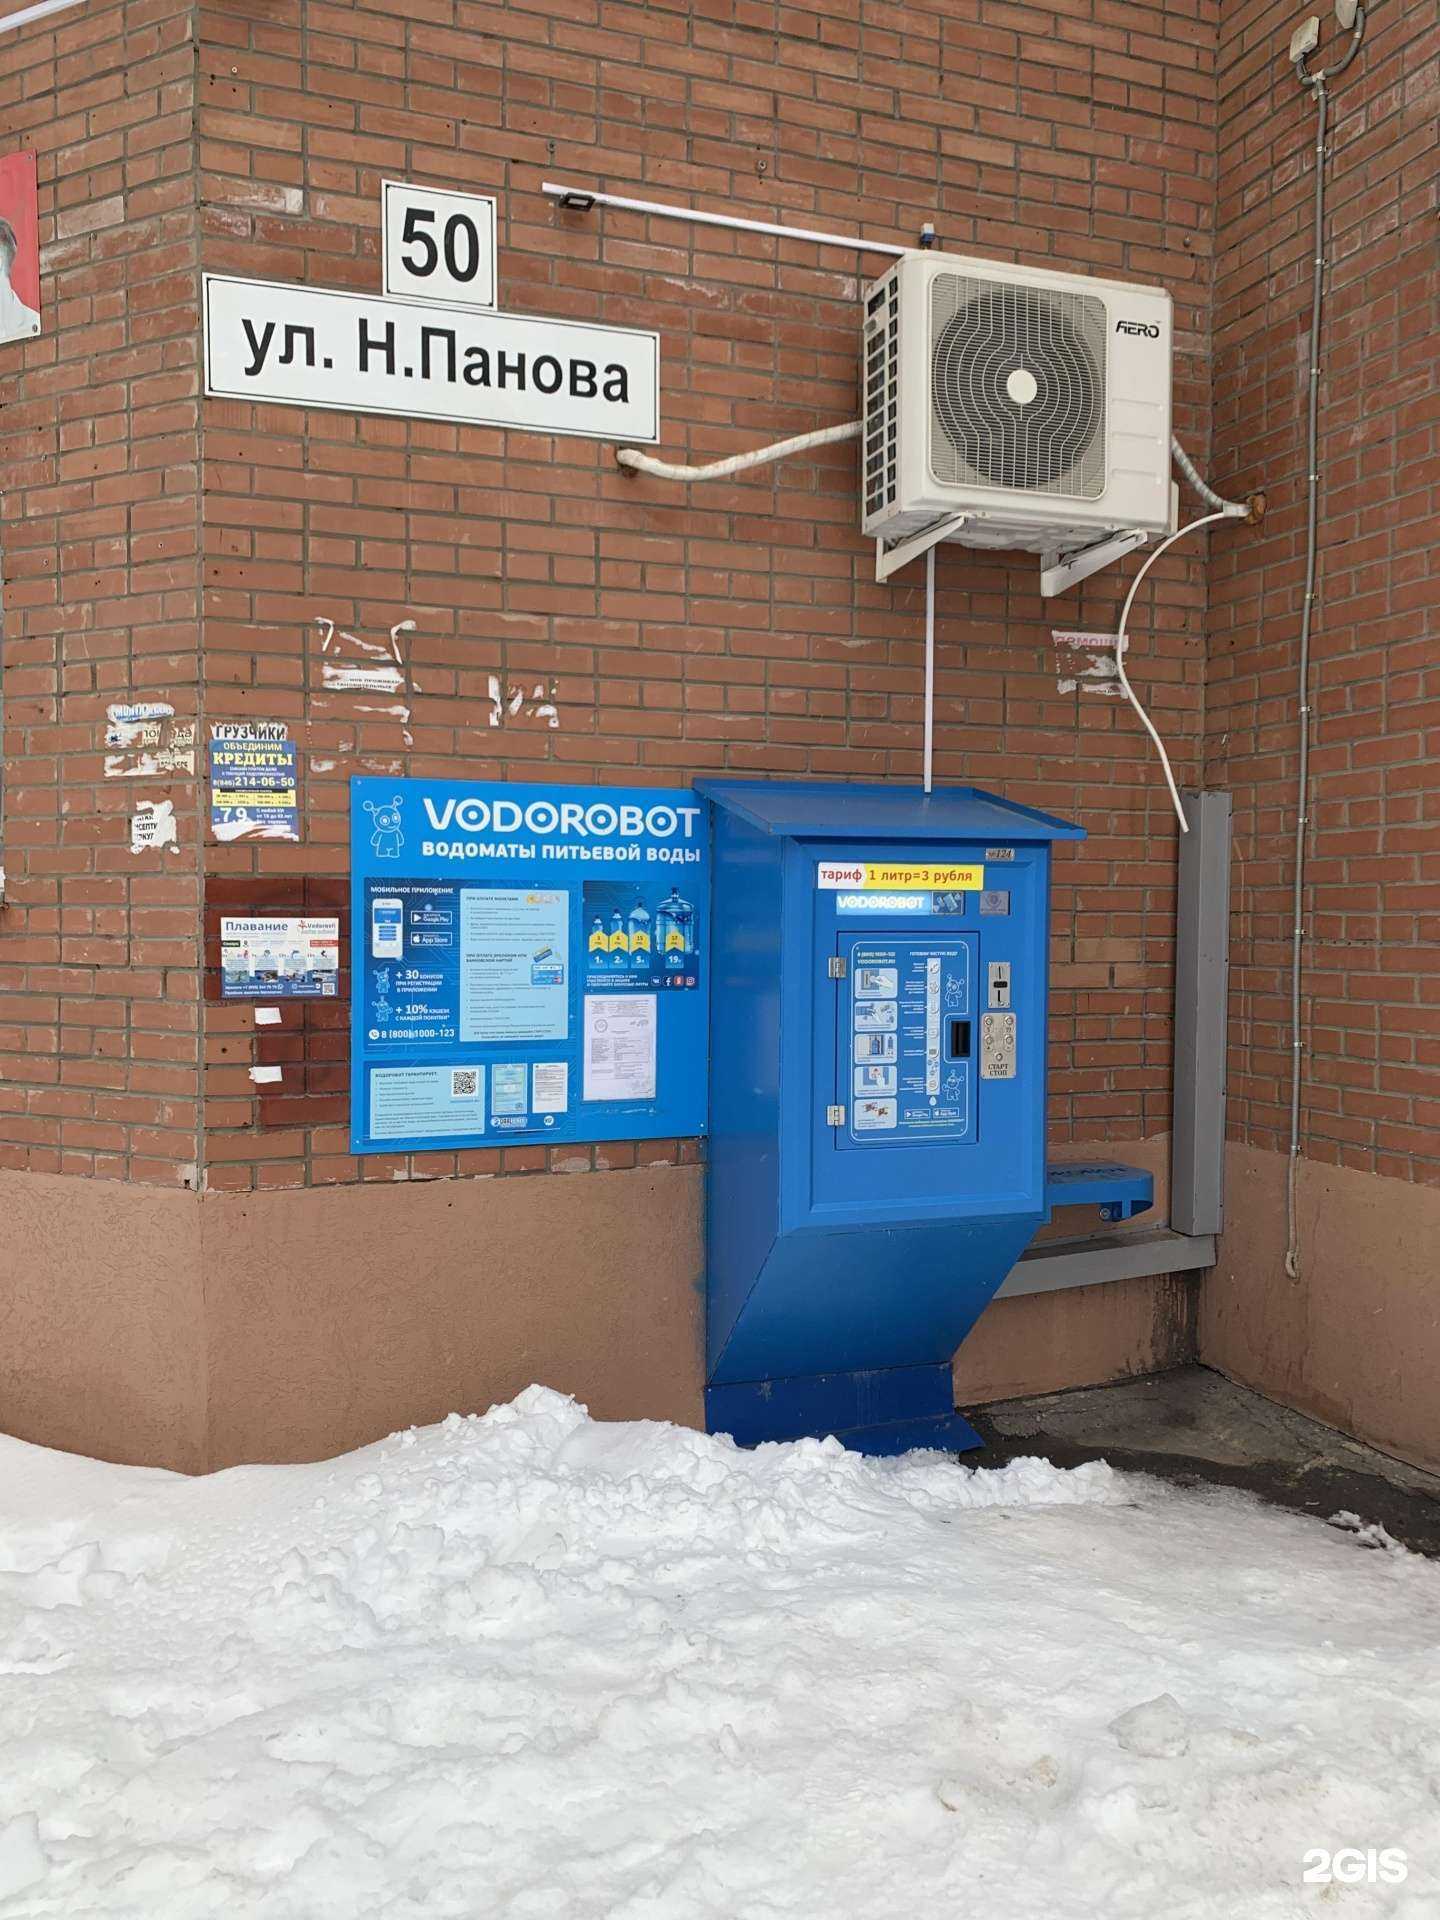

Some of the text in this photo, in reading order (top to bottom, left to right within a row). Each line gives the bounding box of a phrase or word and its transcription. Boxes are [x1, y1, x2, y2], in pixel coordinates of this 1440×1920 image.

[401, 208, 479, 282] 50
[242, 317, 629, 403] ул. Н.Панова
[216, 724, 286, 740] ГРУЗЧИКИ
[223, 742, 282, 751] ОБЪЕДИНИМ
[212, 752, 293, 766] КРЕДИТЫ
[423, 797, 701, 838] VODOROBOT
[422, 841, 701, 865] ВОДОМАТЫ ПИТЬЕВОЙ ВОДЫ
[820, 868, 973, 883] тариф 1 литр=3 рубля
[837, 895, 925, 909] VODOROBOT
[226, 922, 288, 931] Плавание
[405, 969, 419, 979] 30
[405, 1004, 428, 1014] 10%
